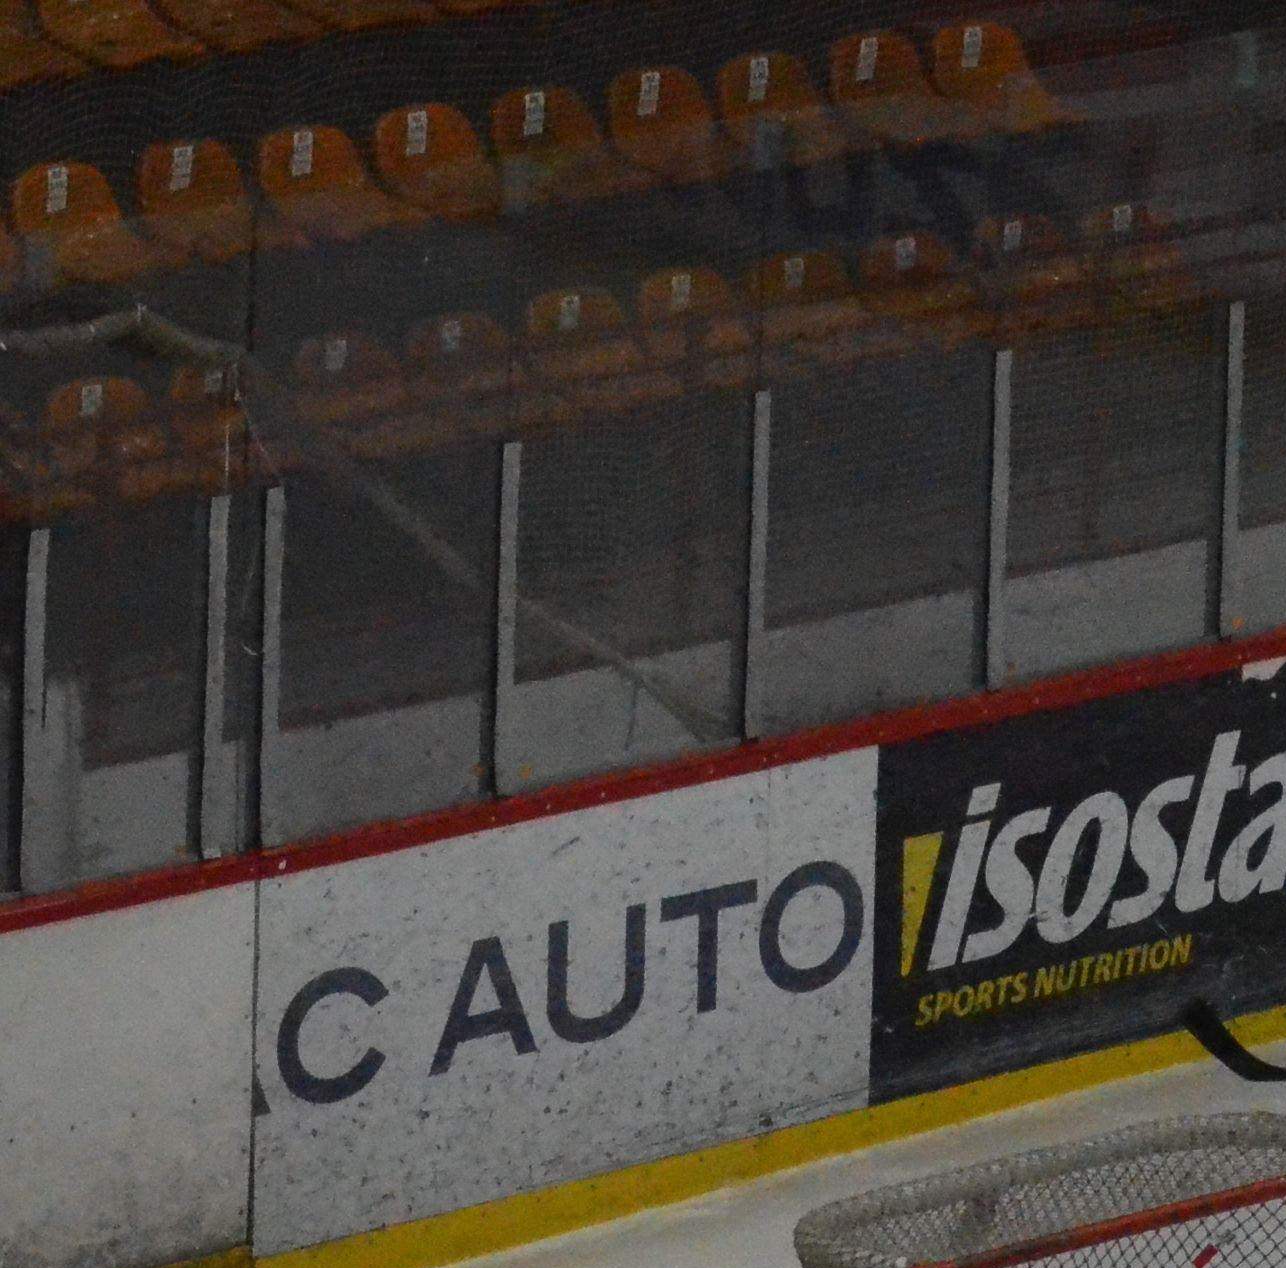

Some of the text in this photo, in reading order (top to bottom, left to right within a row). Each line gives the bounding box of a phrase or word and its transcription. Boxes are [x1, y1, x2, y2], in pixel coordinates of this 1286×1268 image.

[254, 860, 866, 1117] C AUTO
[913, 932, 1194, 1027] SPORTS NUTRITION
